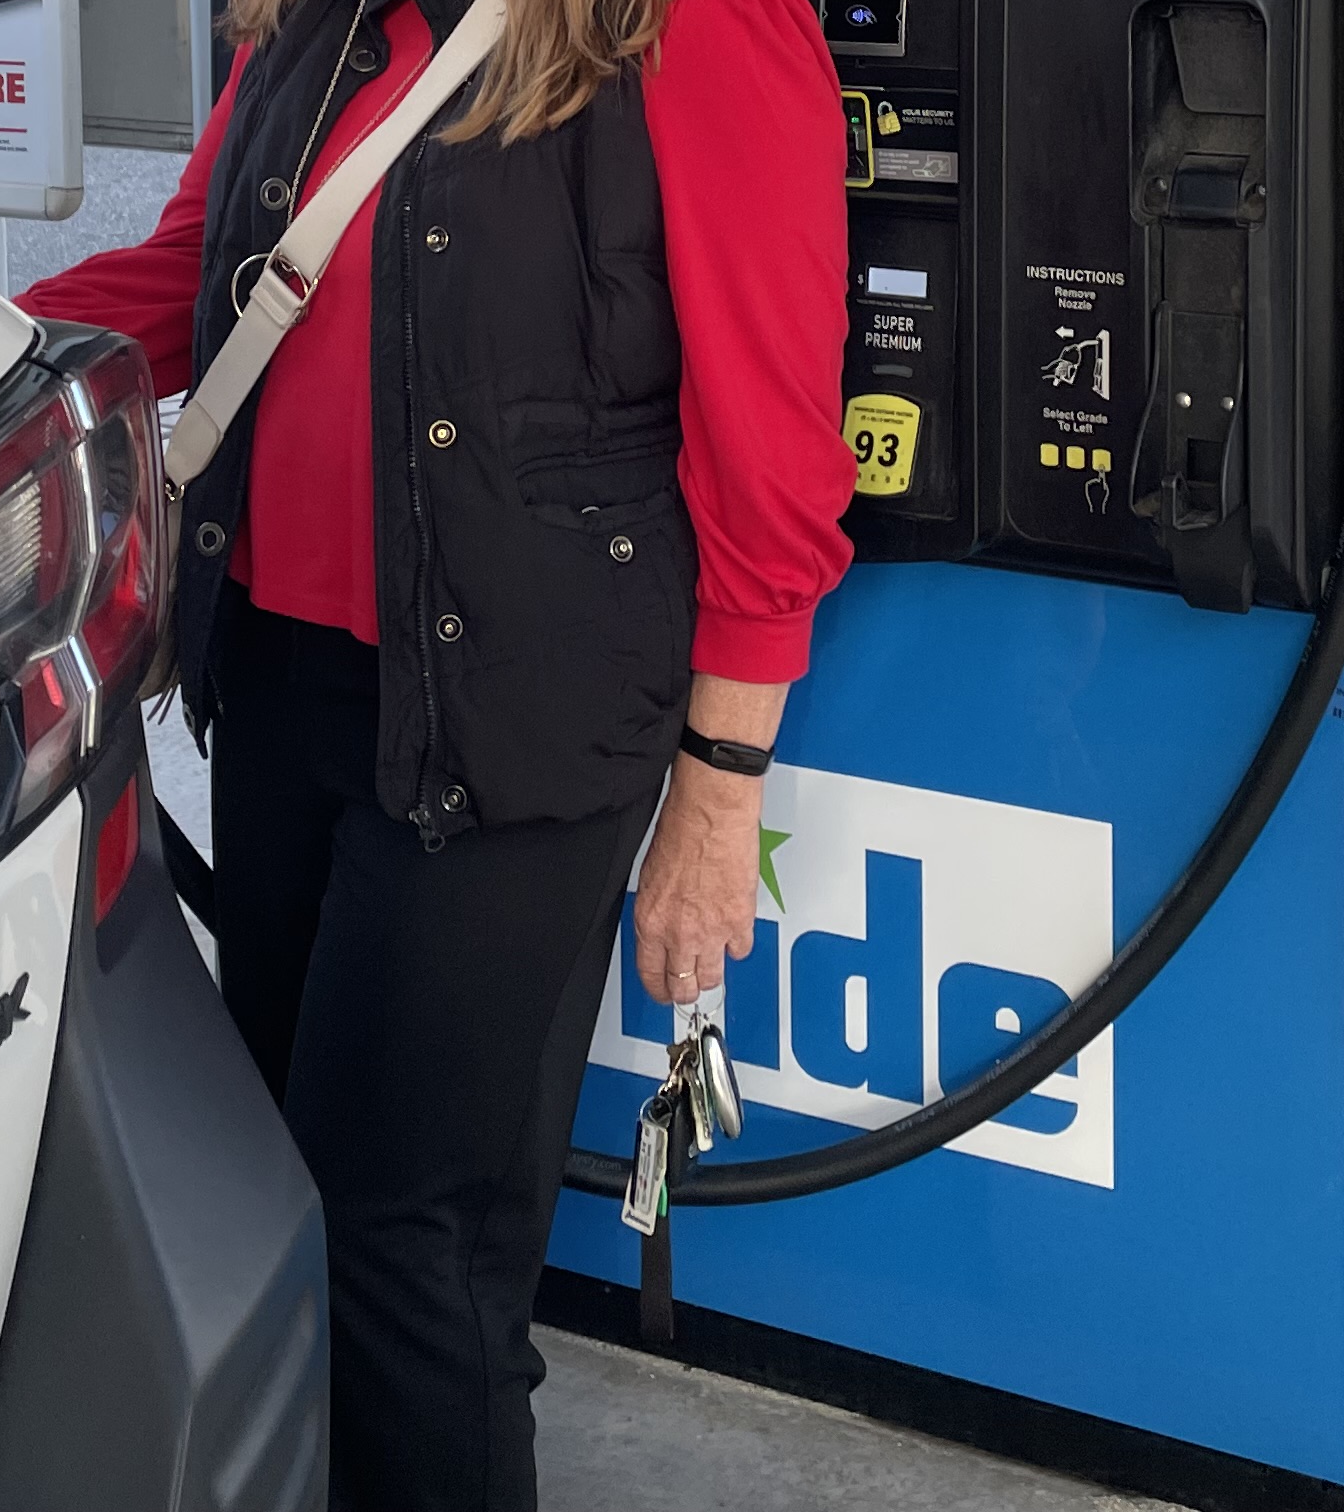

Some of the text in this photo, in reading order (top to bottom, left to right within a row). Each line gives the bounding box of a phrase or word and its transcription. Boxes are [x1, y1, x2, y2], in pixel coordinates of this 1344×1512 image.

[1026, 265, 1125, 286] INSTRUCTIONS
[1055, 287, 1096, 300] Remove
[1058, 299, 1093, 311] Nozzle
[873, 314, 914, 333] SUPER
[865, 332, 922, 352] PREMIUM
[1043, 408, 1108, 425] Select Grade
[1058, 421, 1093, 434] To Left
[855, 430, 899, 467] 93
